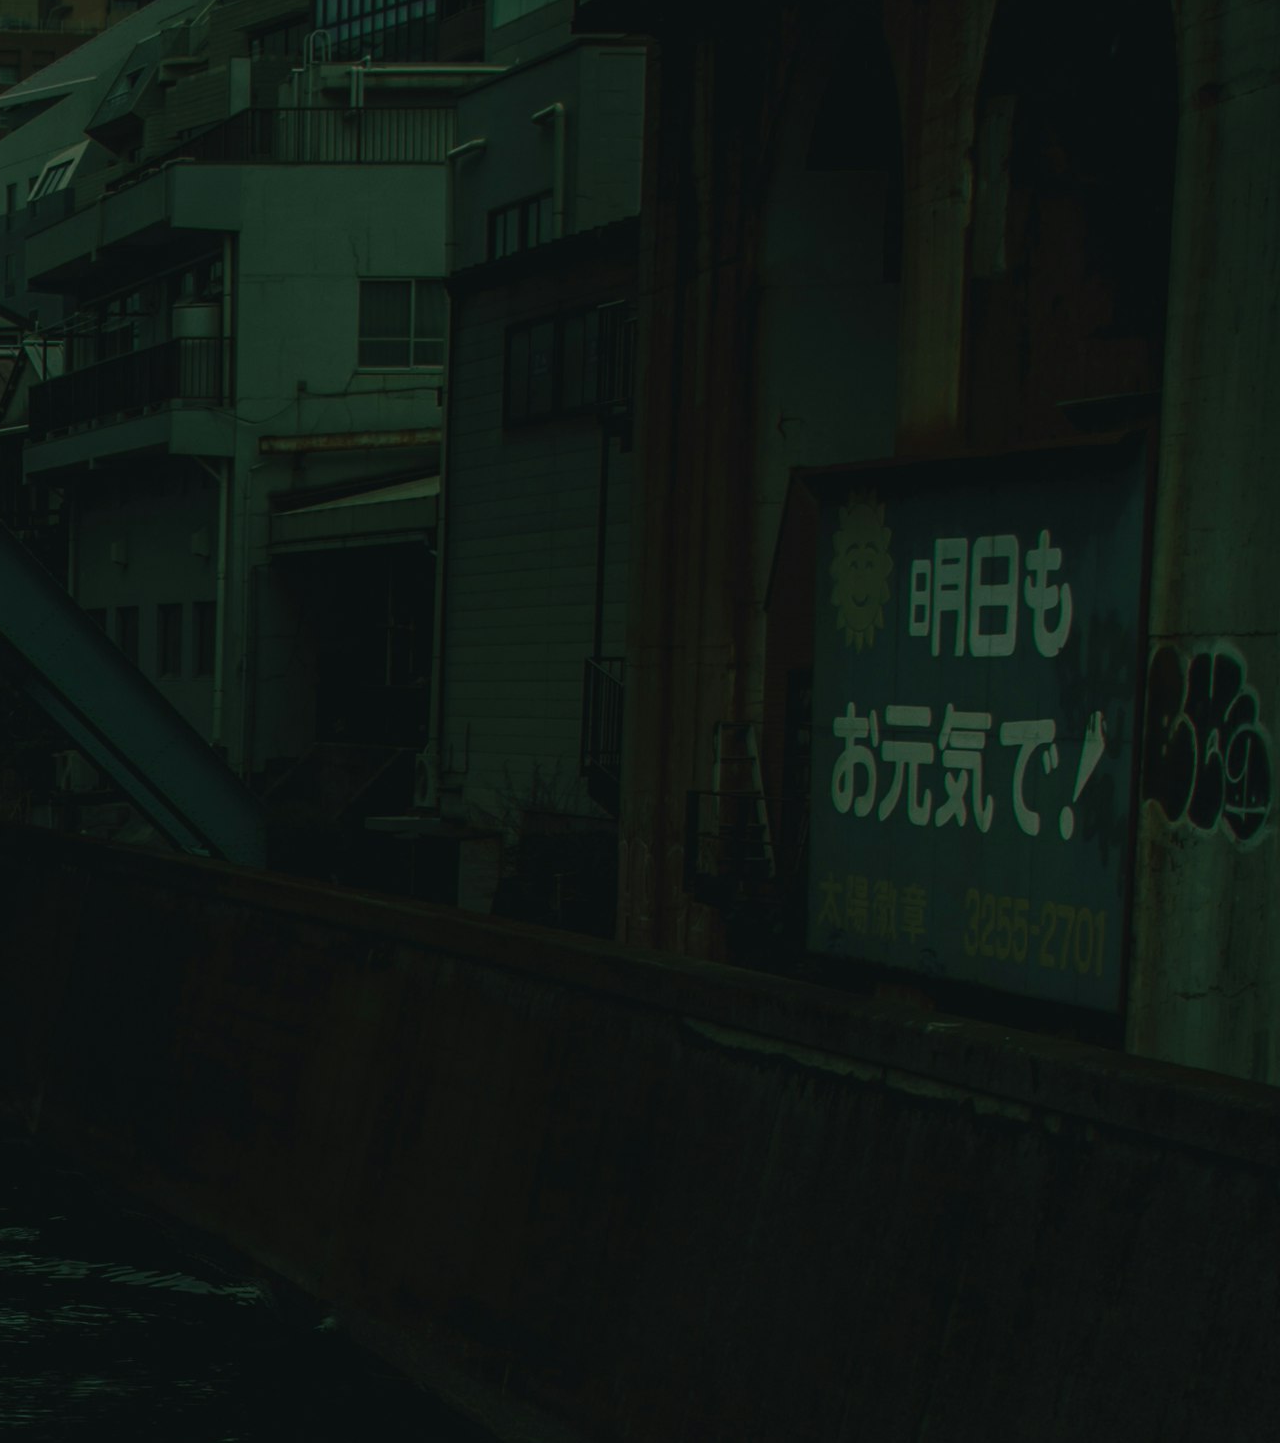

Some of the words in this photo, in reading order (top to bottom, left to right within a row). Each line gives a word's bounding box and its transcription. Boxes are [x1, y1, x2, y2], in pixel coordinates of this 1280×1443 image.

[908, 529, 1073, 658] 明日も
[831, 701, 1106, 841] お元気で!
[963, 886, 1107, 978] 3255-2701
